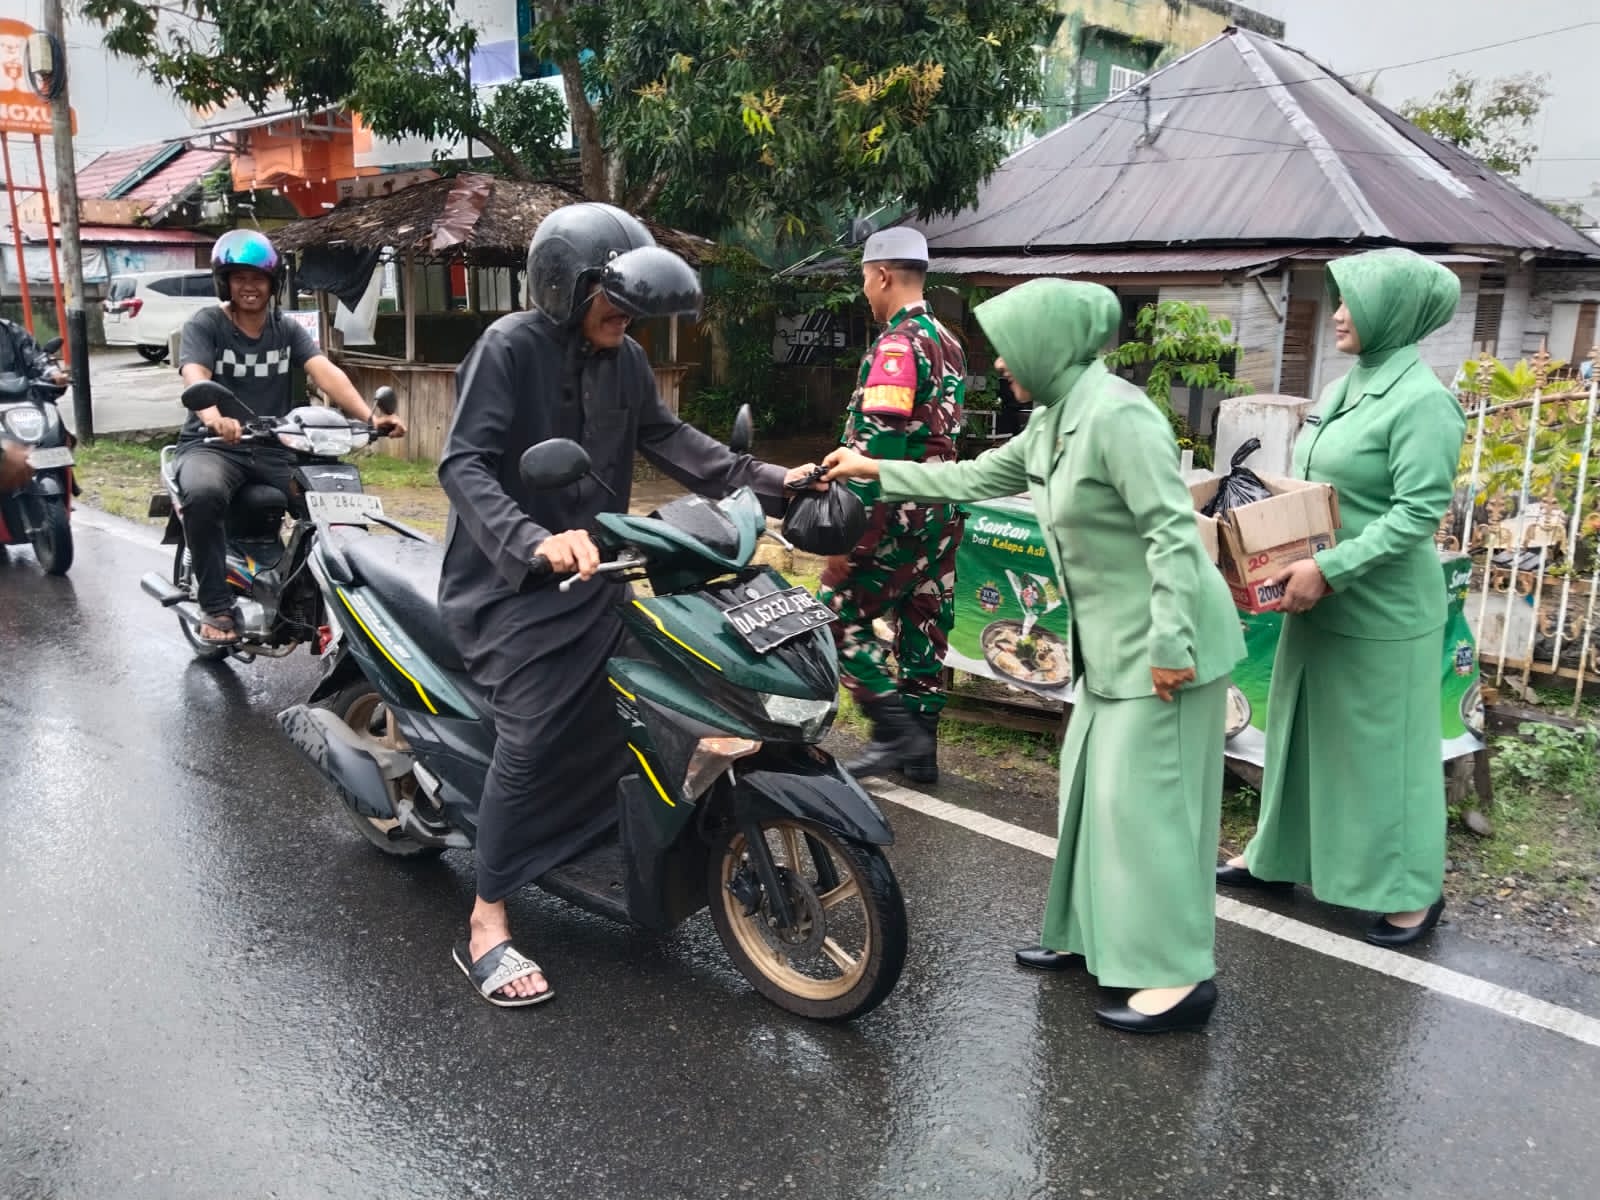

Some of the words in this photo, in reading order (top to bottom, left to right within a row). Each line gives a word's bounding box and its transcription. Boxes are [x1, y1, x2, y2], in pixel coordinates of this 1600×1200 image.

[973, 516, 1031, 540] Santan
[972, 534, 991, 545] Dari
[992, 538, 1024, 554] Kelapa
[1026, 545, 1047, 557] Asli
[1248, 553, 1270, 572] 20
[733, 613, 756, 634] DA
[755, 599, 793, 623] 6232
